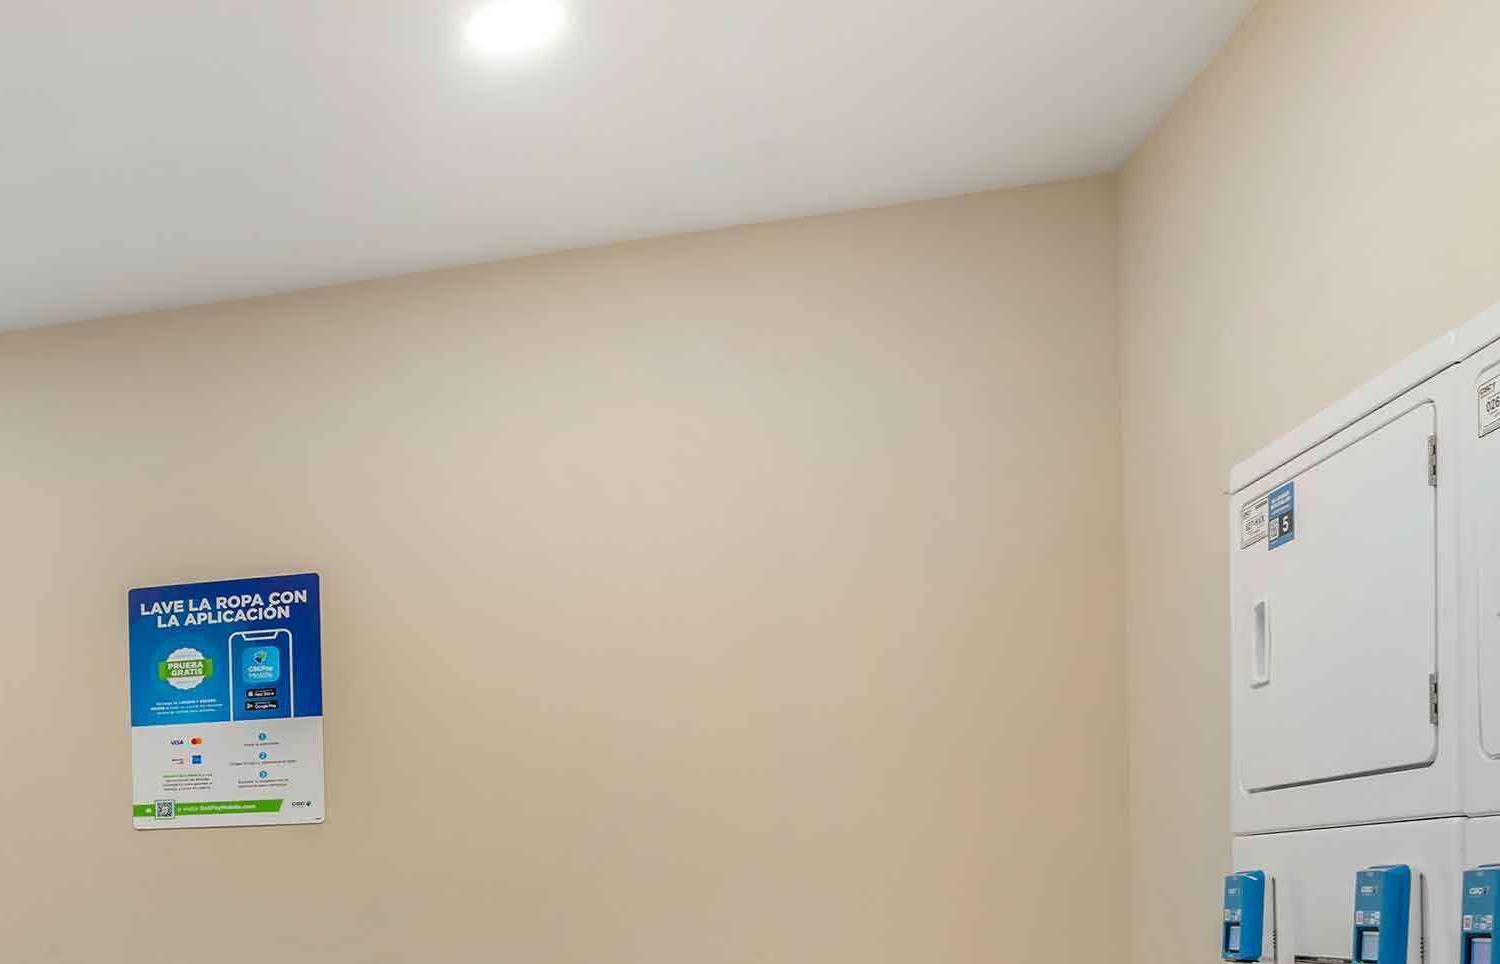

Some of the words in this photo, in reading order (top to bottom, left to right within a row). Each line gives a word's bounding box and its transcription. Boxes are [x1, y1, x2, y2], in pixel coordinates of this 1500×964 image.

[1282, 515, 1289, 532] 5
[140, 600, 184, 616] LAVE
[188, 598, 211, 612] LA
[216, 593, 264, 610] ROPA
[268, 589, 307, 605] CON
[157, 615, 180, 628] LA
[184, 604, 290, 626] APLICACIÓN
[168, 661, 203, 670] PRUEBA
[171, 668, 203, 677] GRATIS
